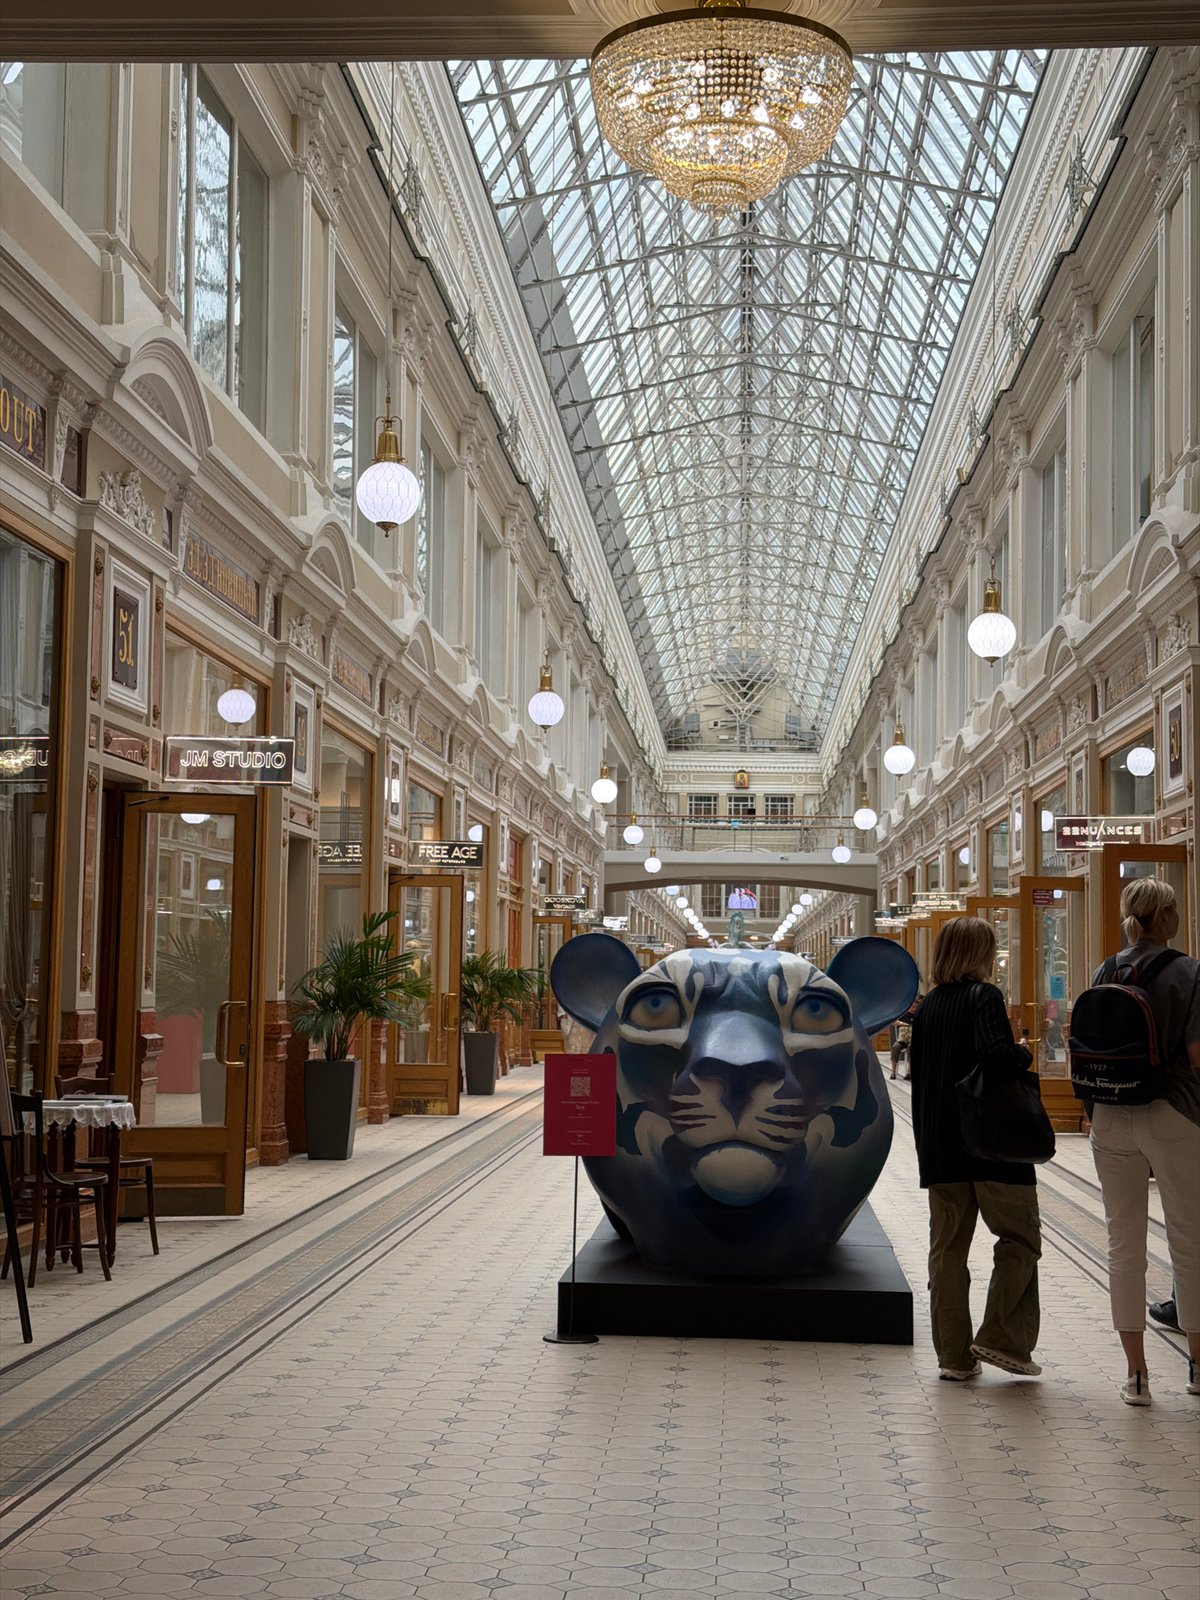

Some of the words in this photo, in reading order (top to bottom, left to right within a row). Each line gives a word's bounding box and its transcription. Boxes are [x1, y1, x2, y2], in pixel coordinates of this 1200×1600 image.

[180, 750, 209, 768] JM
[212, 750, 287, 769] STUDIO
[418, 845, 449, 858] FREE
[451, 845, 478, 859] AGE
[1089, 1063, 1107, 1071] 1927
